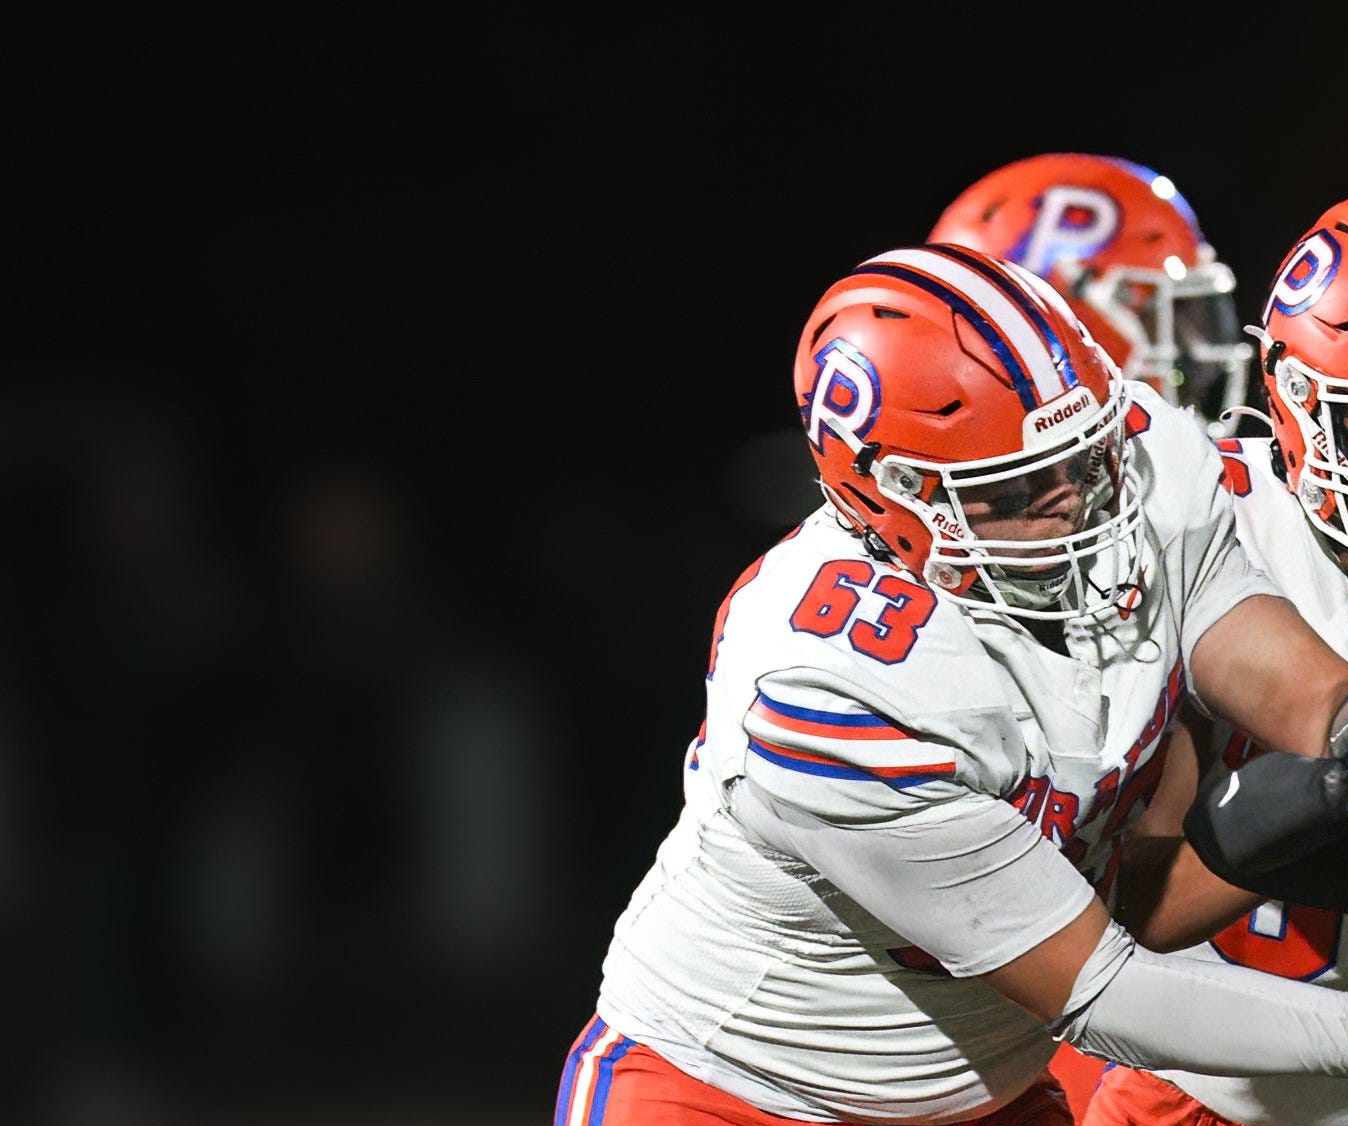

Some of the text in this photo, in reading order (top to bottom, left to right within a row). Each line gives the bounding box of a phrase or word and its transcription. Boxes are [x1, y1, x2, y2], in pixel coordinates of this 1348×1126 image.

[800, 336, 882, 456] P
[1033, 393, 1092, 433] Riddell
[788, 558, 938, 666] 63
